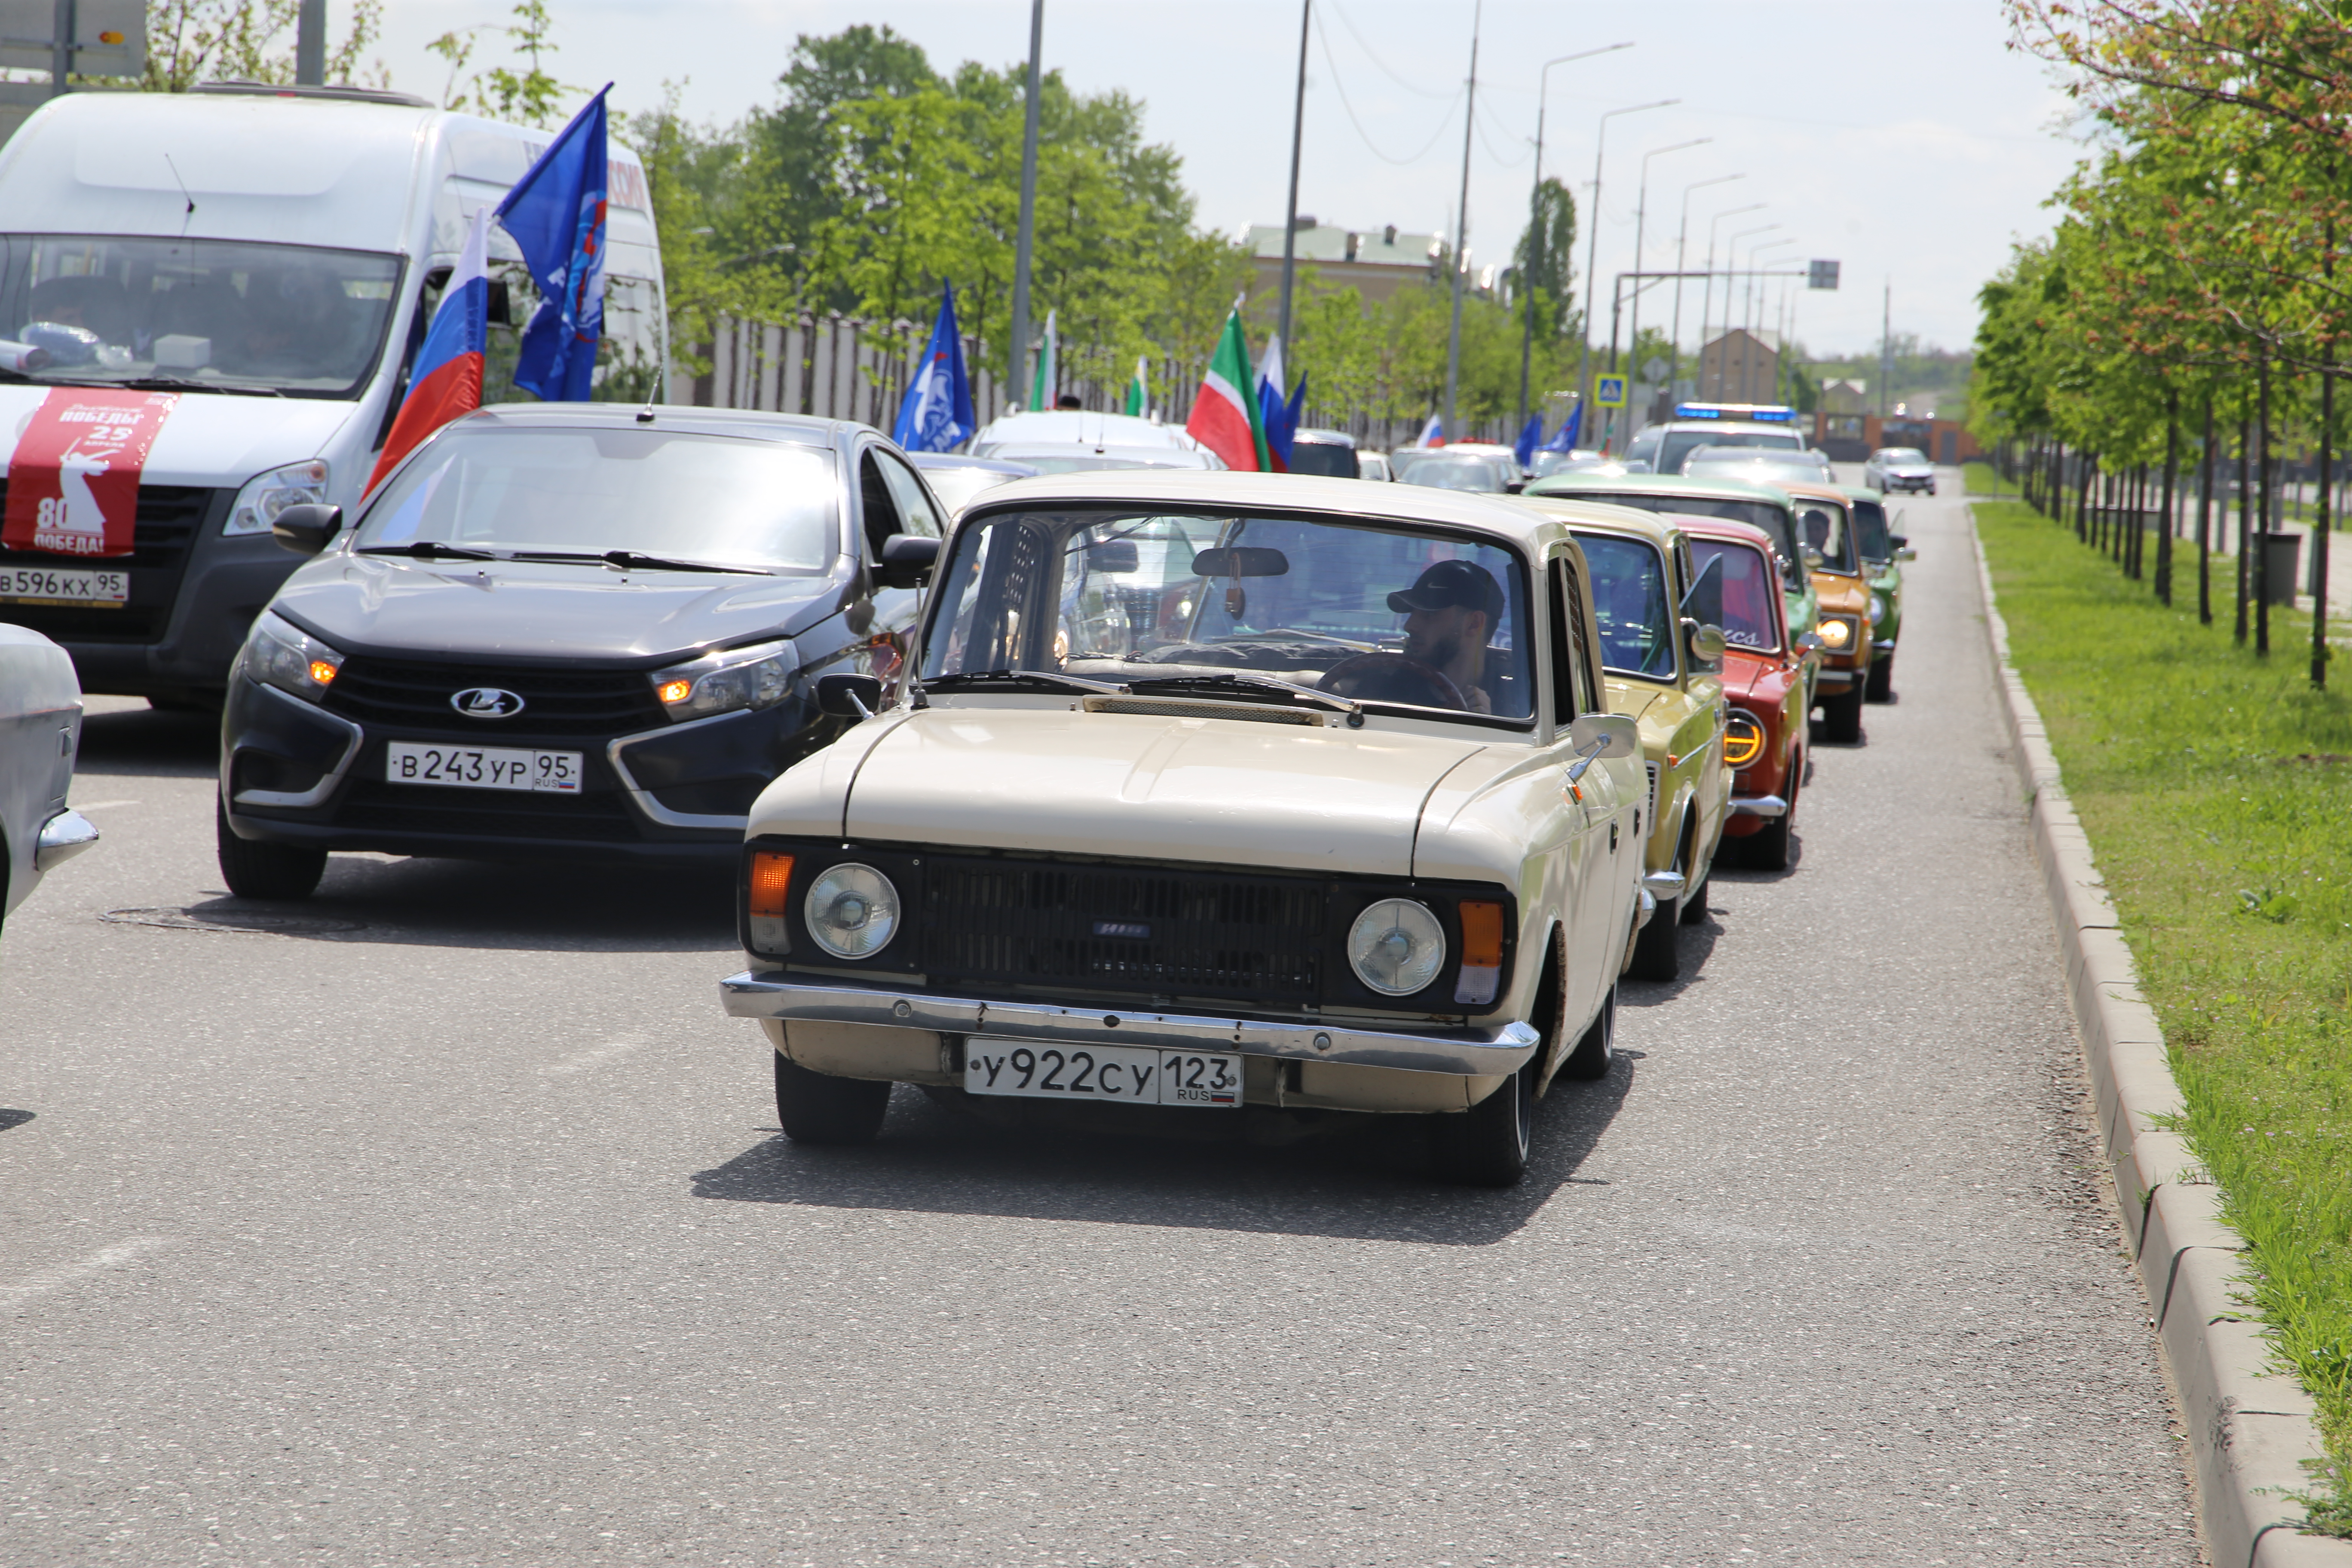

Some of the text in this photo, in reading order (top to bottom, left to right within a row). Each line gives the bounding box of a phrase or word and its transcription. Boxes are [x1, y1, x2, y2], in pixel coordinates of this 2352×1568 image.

[59, 410, 140, 425] ПОБЕДЫ
[88, 425, 132, 441] 25
[37, 497, 67, 528] 80
[34, 533, 104, 554] ПОБЕДА!
[98, 574, 120, 591] 95
[538, 755, 569, 778] 95
[535, 778, 558, 788] RUS
[1164, 1057, 1228, 1089] 123
[1177, 1089, 1209, 1101] RUS
